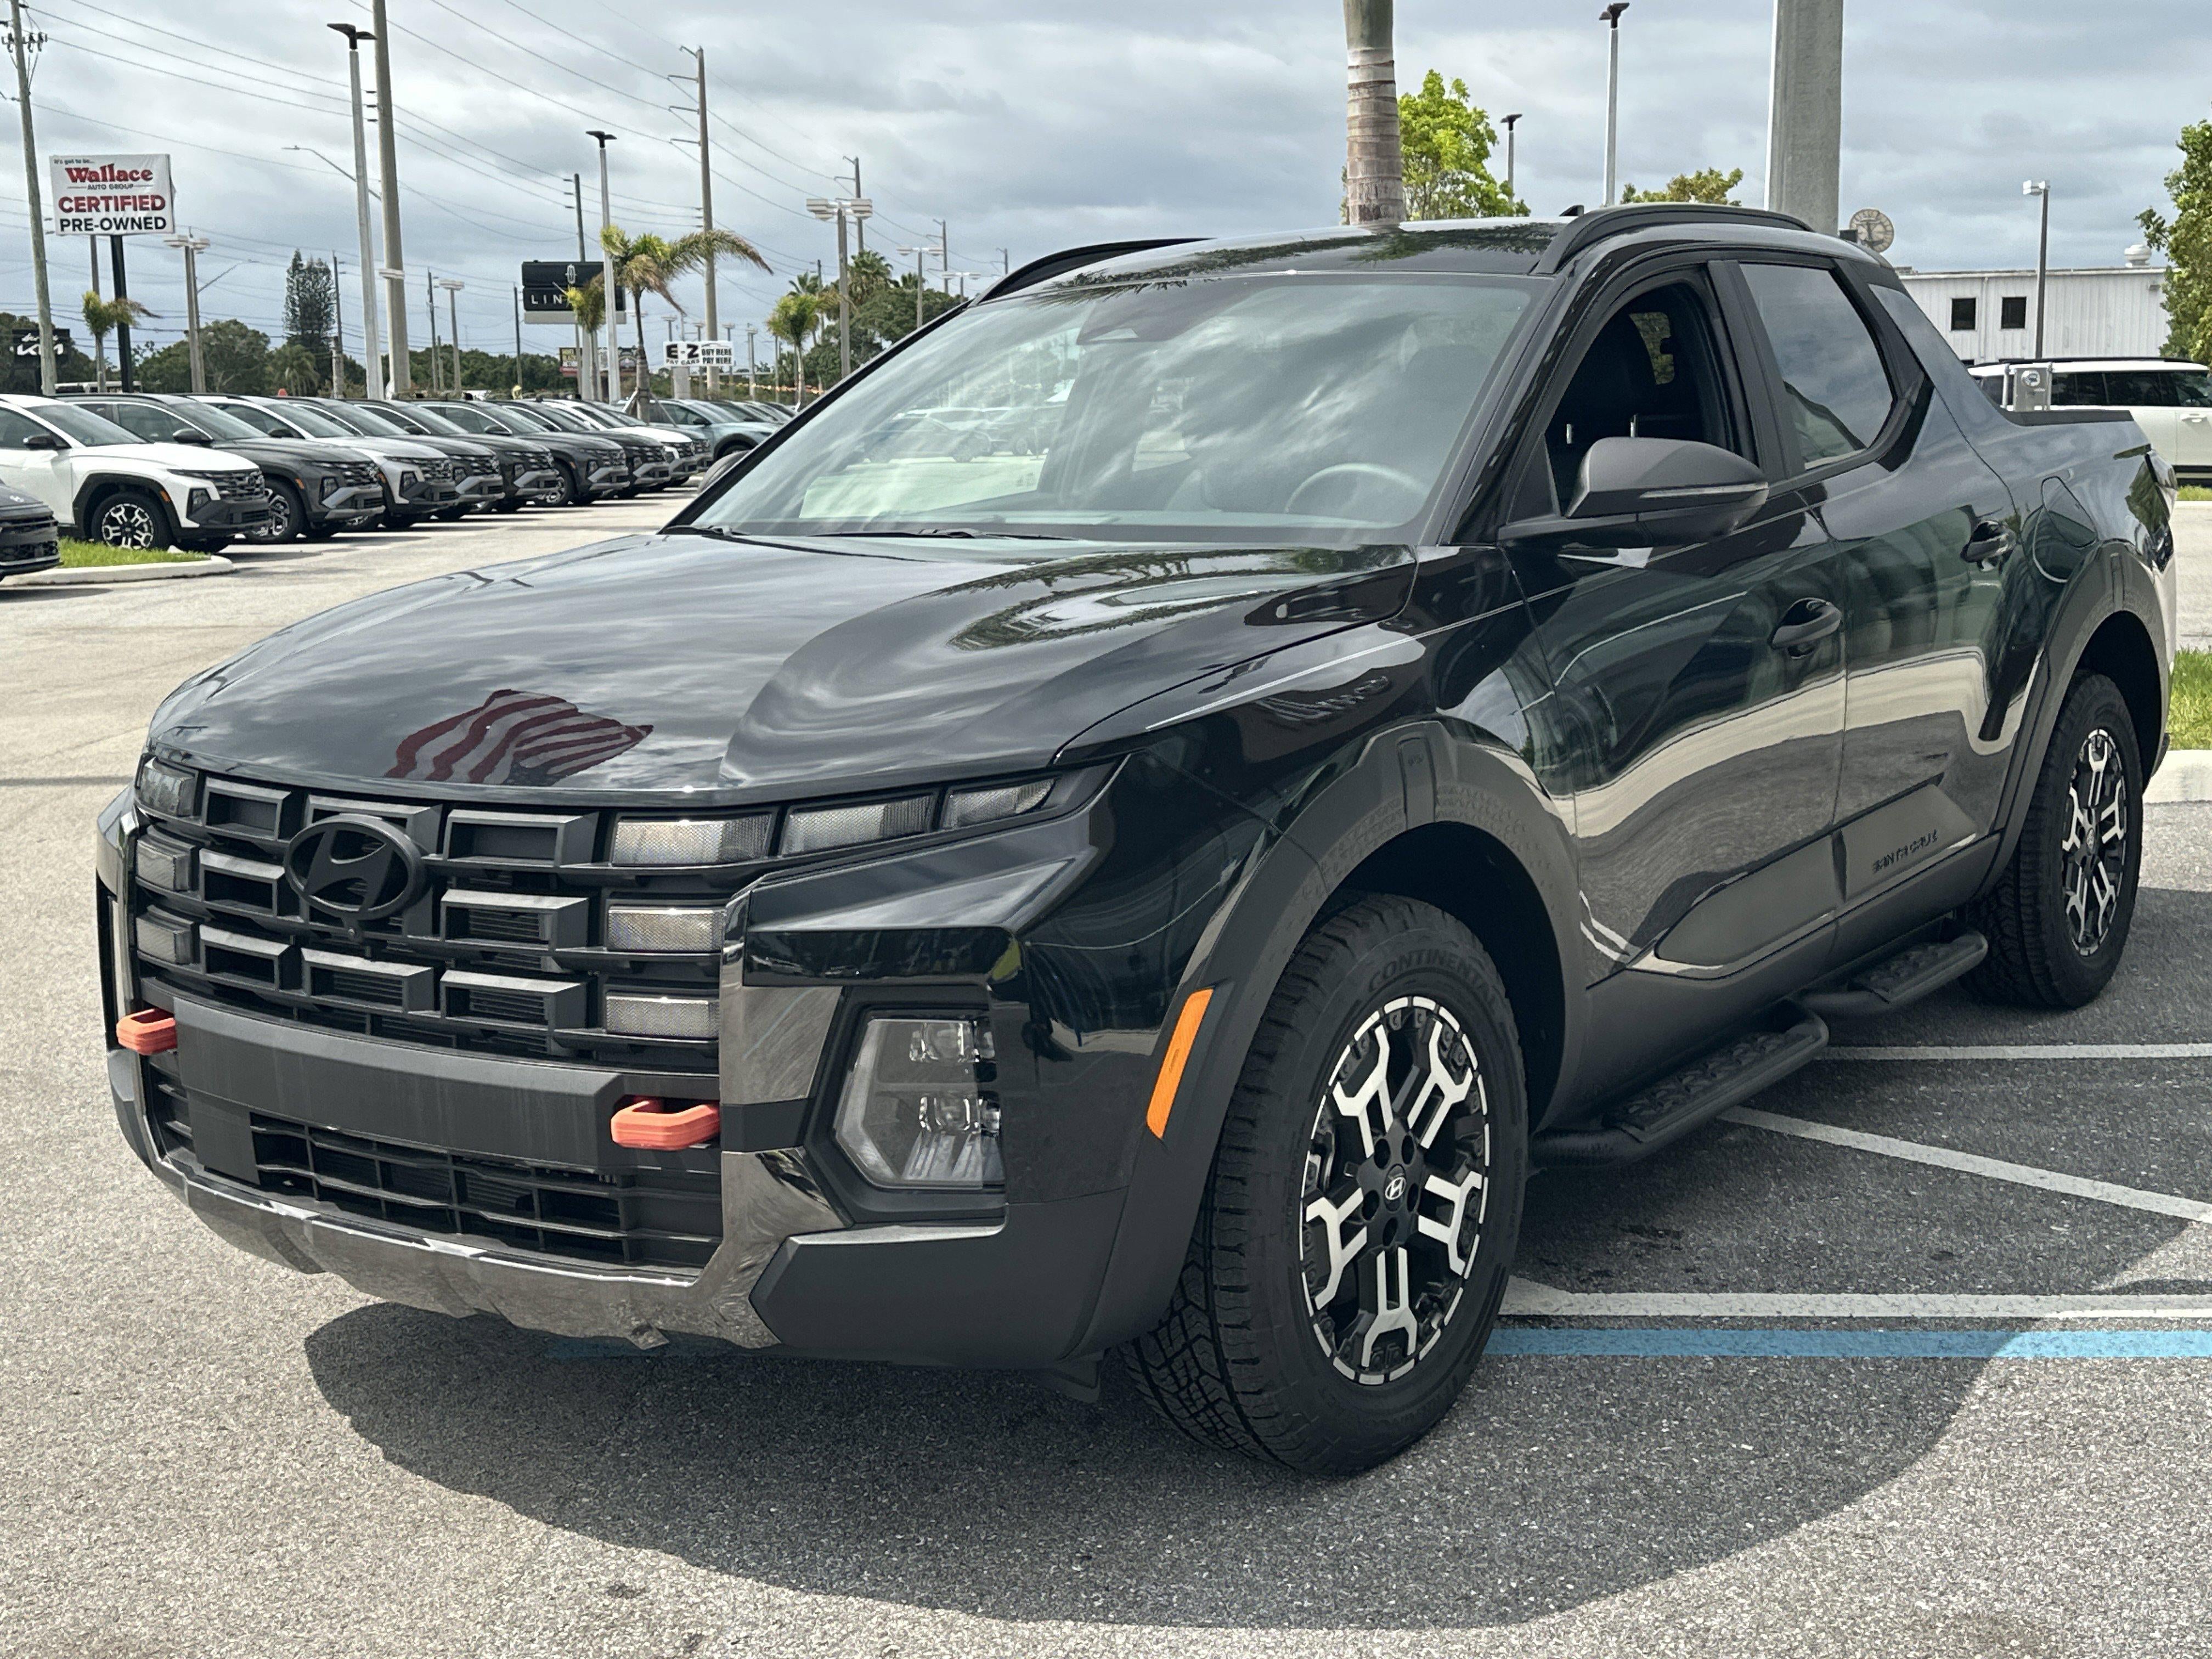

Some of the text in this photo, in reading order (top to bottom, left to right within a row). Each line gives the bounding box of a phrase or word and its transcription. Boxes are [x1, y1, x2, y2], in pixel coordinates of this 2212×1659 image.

[65, 163, 154, 183] Wallace
[58, 195, 166, 213] CERTIFIED
[59, 216, 167, 232] PRE-OWNED
